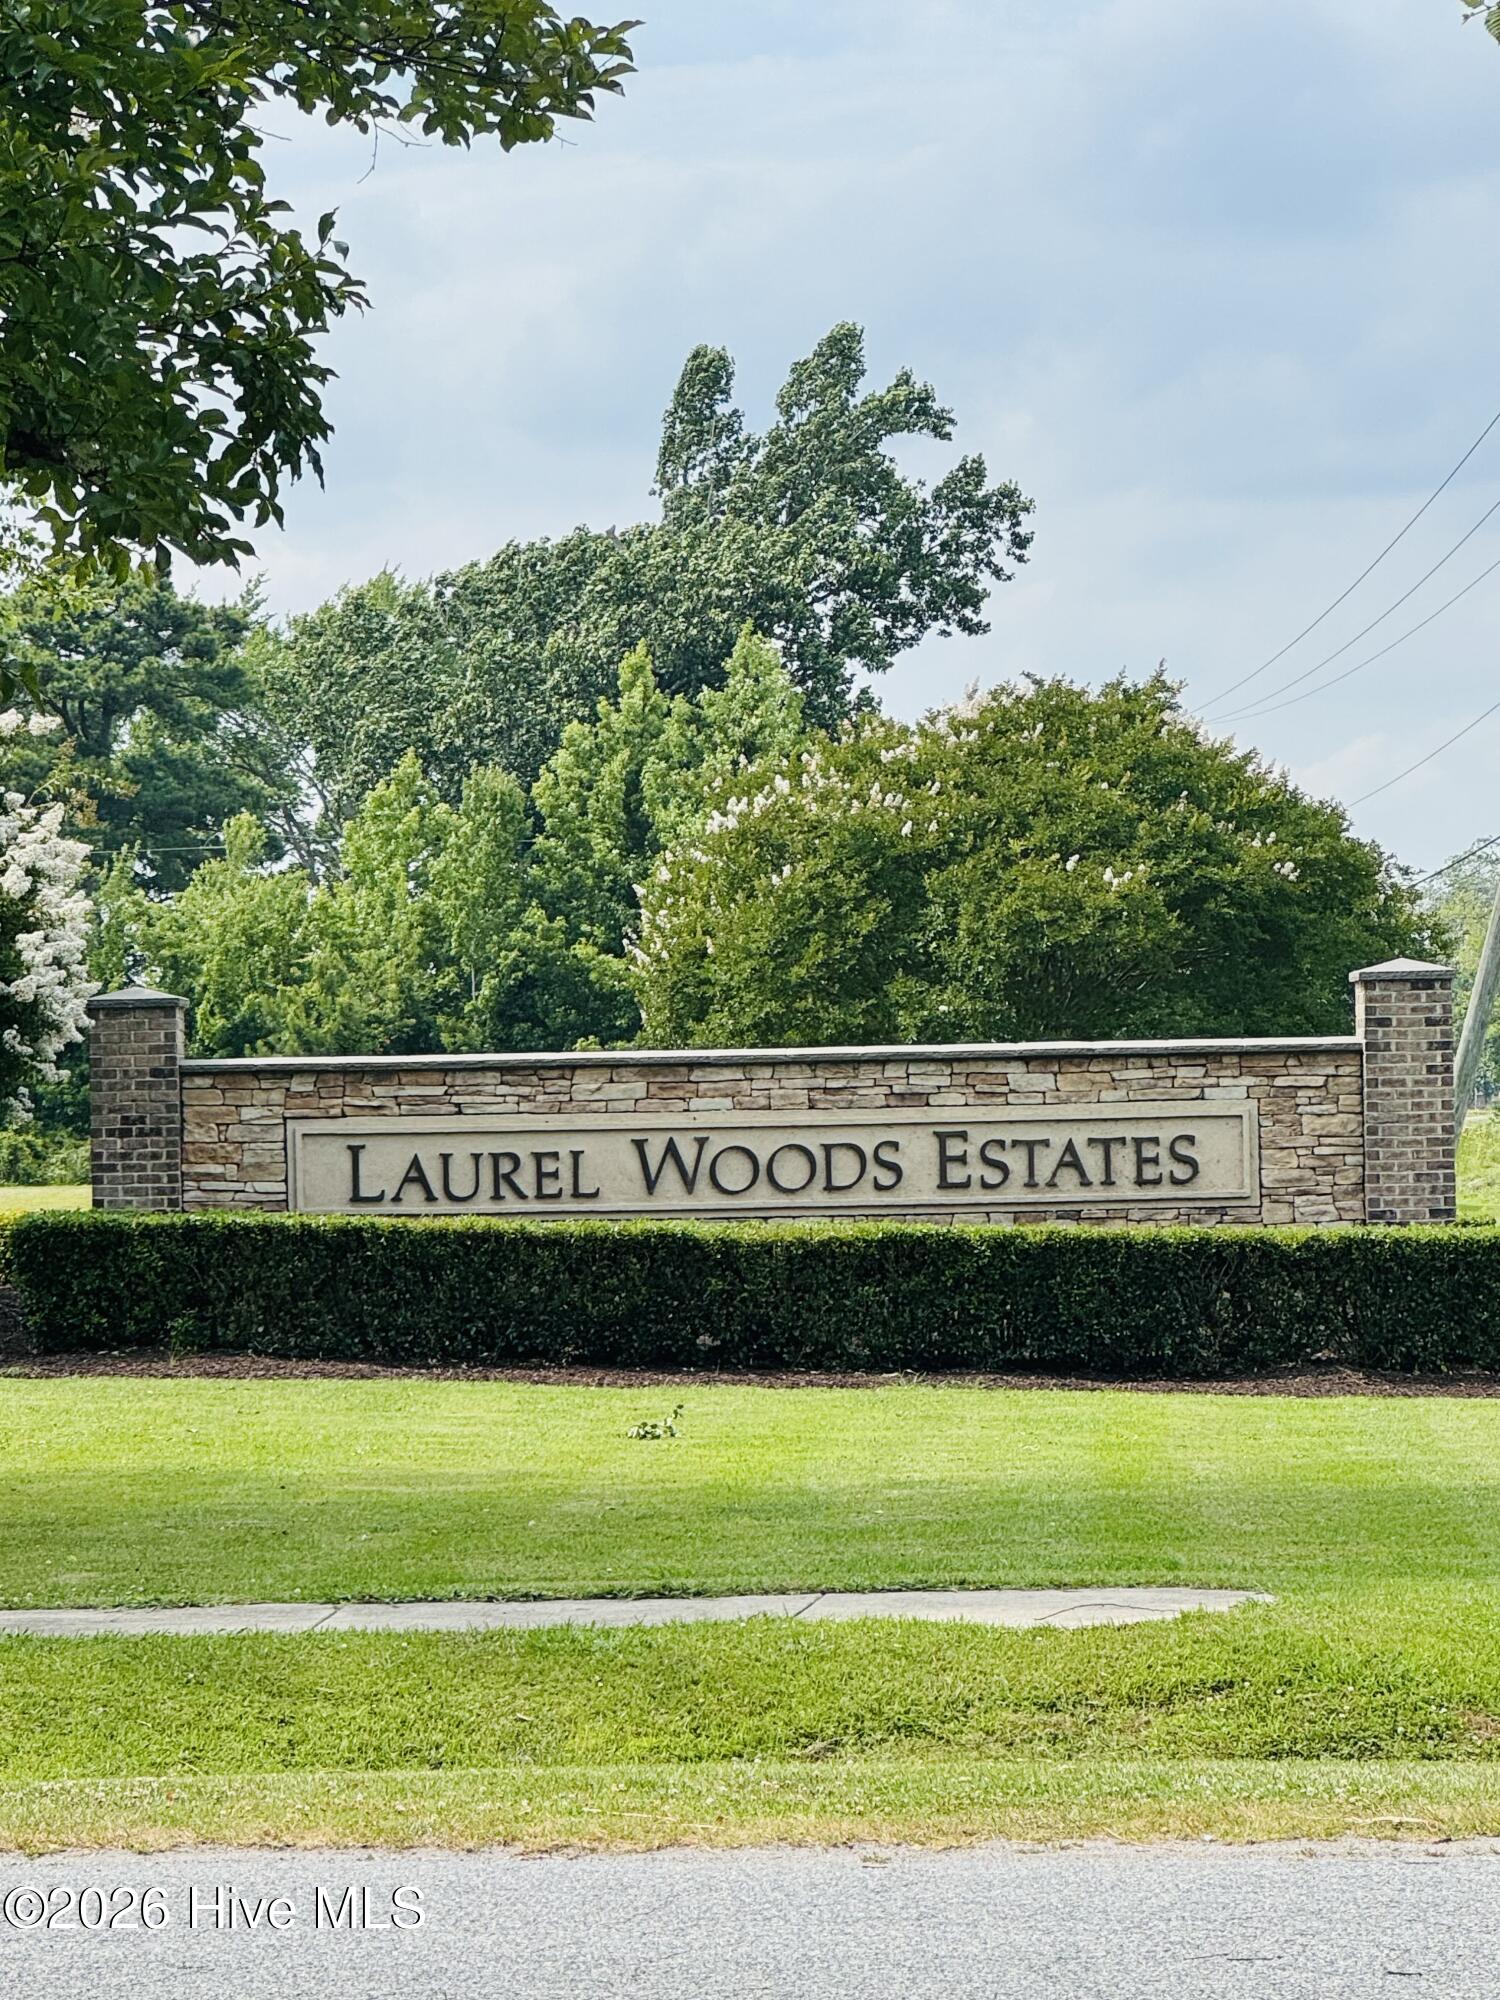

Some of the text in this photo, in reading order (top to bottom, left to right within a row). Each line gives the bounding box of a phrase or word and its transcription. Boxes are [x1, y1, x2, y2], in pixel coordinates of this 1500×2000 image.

[346, 1130, 1200, 1202] LAUREL WOODS ESTATES
